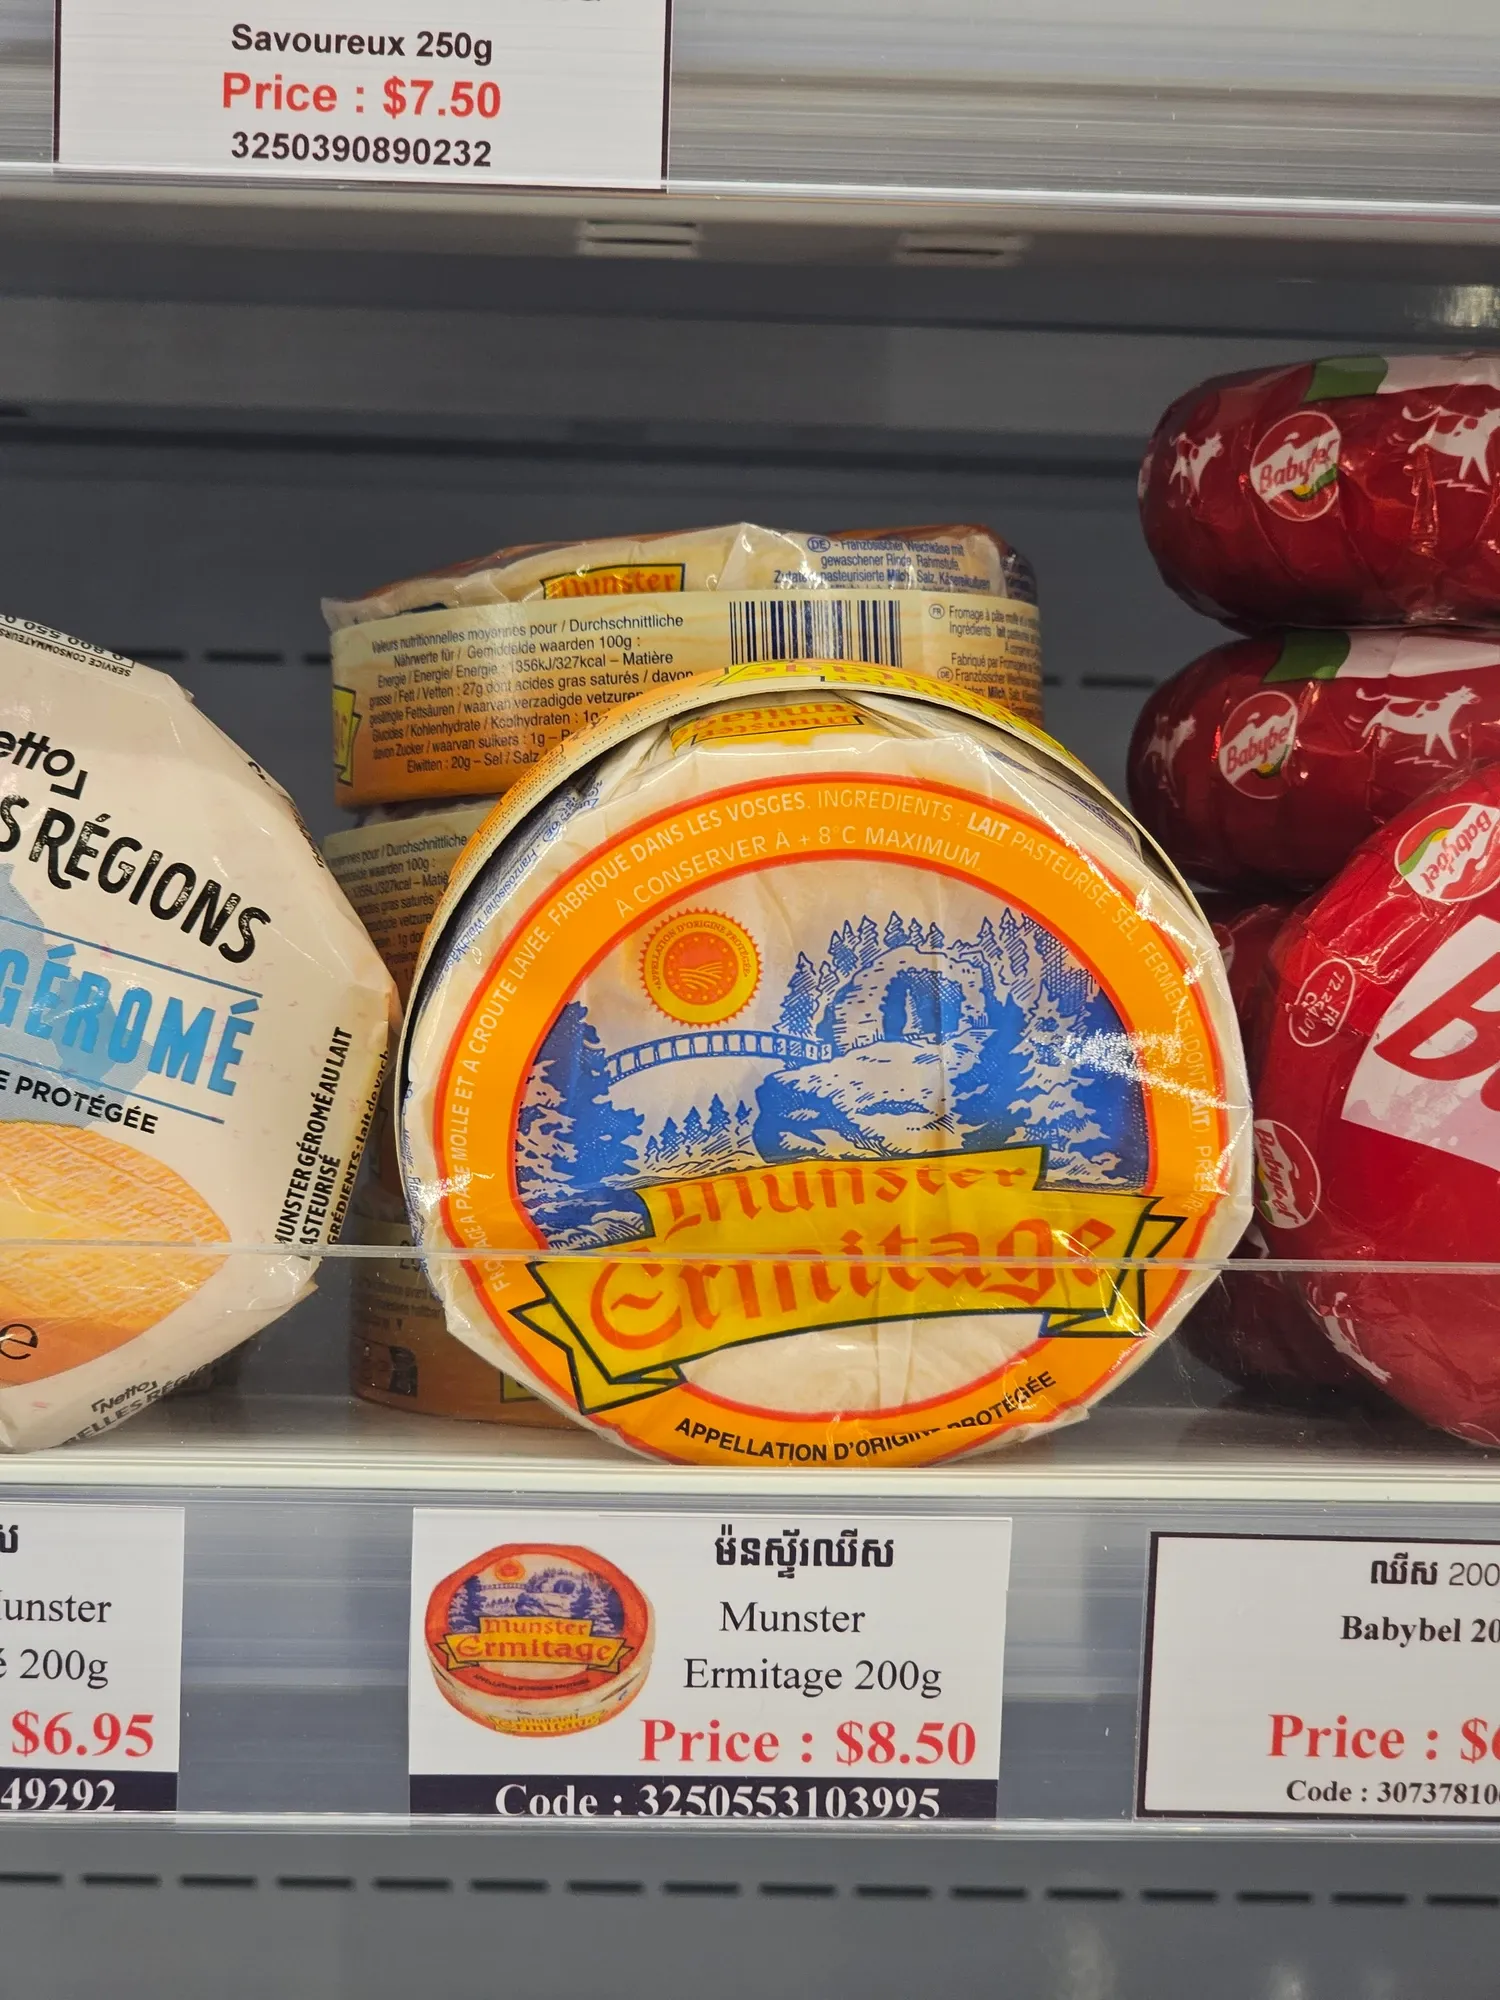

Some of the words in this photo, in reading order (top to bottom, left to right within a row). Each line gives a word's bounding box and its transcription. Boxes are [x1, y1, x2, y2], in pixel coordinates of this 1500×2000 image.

[231, 23, 405, 58] Savoureux
[416, 31, 493, 66] 250g
[222, 72, 339, 114] Price
[383, 77, 502, 121] $7.50
[231, 131, 492, 168] 3250390890232
[821, 555, 884, 568] gewaschener
[399, 630, 465, 650] nutritionnelles
[529, 622, 558, 638] pour
[560, 620, 566, 632] /
[569, 613, 684, 633] Durchschnittliche
[949, 605, 984, 622] Fromage
[88, 657, 132, 677] SERVICE
[393, 652, 439, 669] Nährwerte
[440, 649, 455, 662] für
[539, 637, 595, 652] waarden
[599, 635, 633, 652] 100g
[622, 651, 673, 667] Matière
[951, 652, 986, 668] Fabriqué
[422, 684, 454, 700] Vetten
[462, 682, 483, 698] 27g
[557, 674, 586, 690] gras
[590, 669, 640, 686] saturés
[405, 703, 455, 721] Fettsäuren
[514, 693, 584, 712] verzadigde
[395, 742, 424, 757] Zucker
[431, 738, 476, 753] waarvan
[478, 734, 519, 749] suikers
[530, 732, 546, 748] 1g
[410, 718, 481, 738] Kohlenhydrate
[450, 756, 472, 772] 20g
[484, 751, 503, 766] Sel
[512, 749, 540, 764] Salz
[1225, 722, 1296, 775] Babybel
[685, 809, 722, 836] LES
[966, 811, 1011, 842] LAIT
[386, 834, 468, 857] Durchschnittliche
[630, 823, 685, 864] DANS
[28, 807, 273, 964] RÉGIONS
[633, 835, 767, 906] CONSERVER
[775, 828, 791, 850] À
[467, 979, 518, 1055] CROUTE
[329, 1026, 353, 1069] LAIT
[318, 1066, 342, 1095] AU
[455, 1079, 476, 1101] ET
[15, 1075, 159, 1135] PROTÉGÉE
[296, 1091, 335, 1168] GÉROMÉ
[451, 1104, 471, 1160] MOLLE
[662, 1161, 1029, 1241] Munster
[590, 1216, 1116, 1350] Ermitage
[675, 1416, 828, 1462] APPELLATION
[0, 1589, 113, 1623] unster
[719, 1600, 866, 1635] Munster
[1340, 1615, 1462, 1648] Babybel
[20, 1648, 109, 1689] 200g
[682, 1656, 843, 1698] Ermitage
[854, 1661, 942, 1699] 200g
[12, 1710, 155, 1759] $6.95
[638, 1718, 780, 1764] Price
[801, 1731, 814, 1764] :
[836, 1720, 977, 1768] $8.50
[1267, 1713, 1406, 1760] Price
[495, 1783, 600, 1818] Code
[637, 1785, 941, 1820] 3250553103995
[1286, 1779, 1353, 1803] Code
[1376, 1781, 1500, 1805] 30737810
